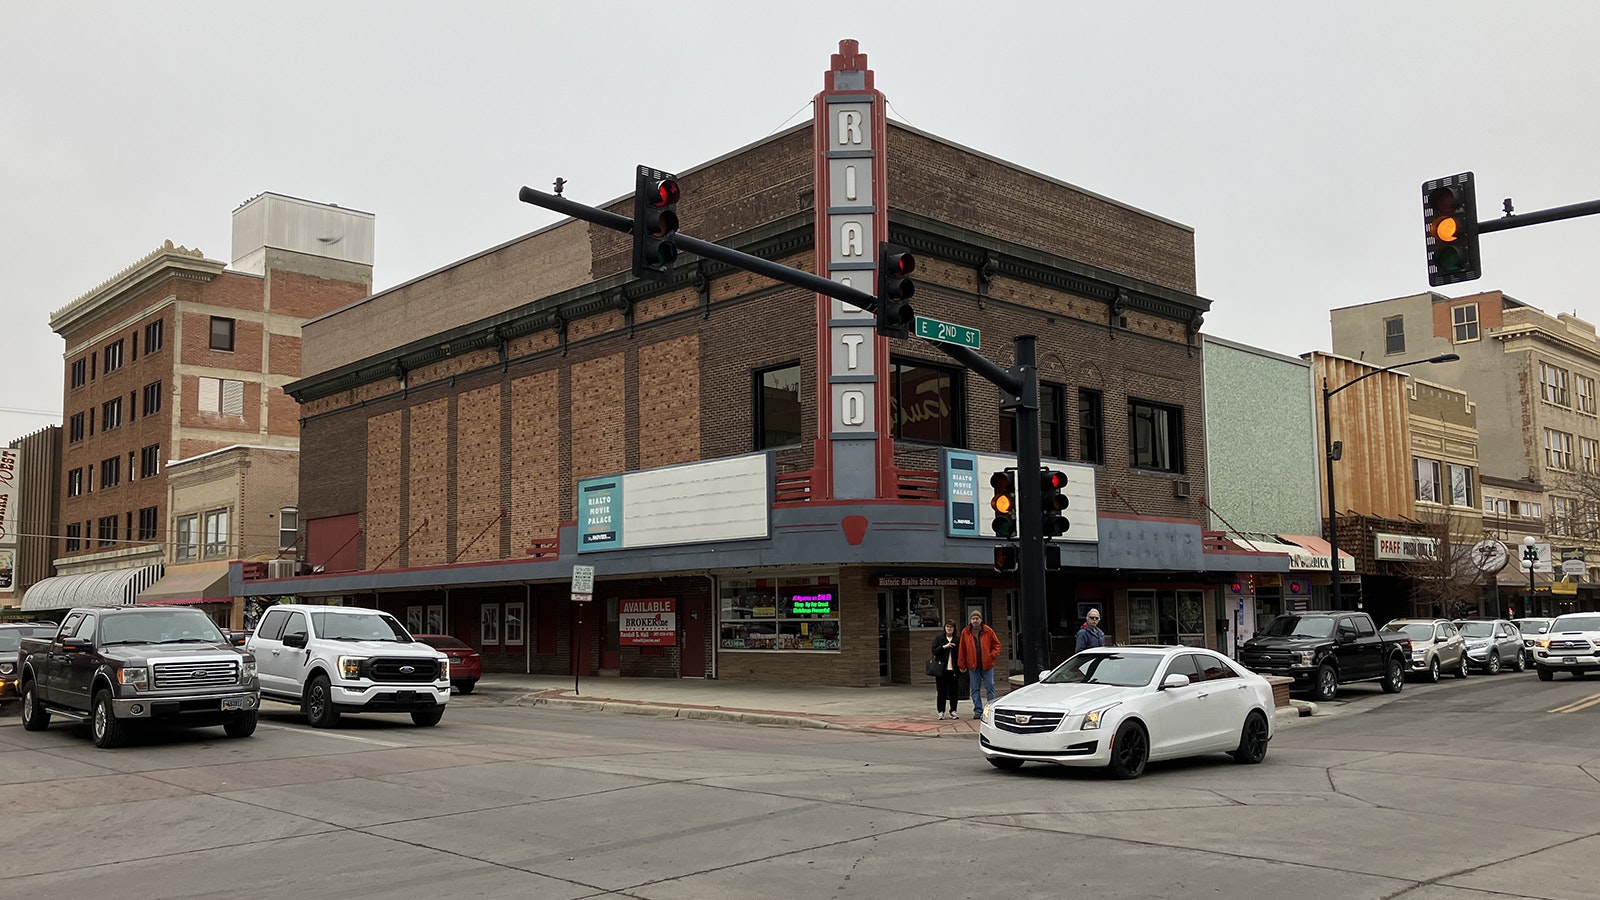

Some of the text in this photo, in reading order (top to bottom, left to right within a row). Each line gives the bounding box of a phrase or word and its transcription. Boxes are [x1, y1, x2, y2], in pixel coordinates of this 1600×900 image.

[838, 109, 865, 426] RIALTO
[922, 321, 975, 343] E 2ND ST
[952, 474, 973, 482] RIALTO
[588, 496, 611, 506] RIALTO
[589, 506, 610, 515] MOVIE
[587, 515, 612, 525] PALACE
[1380, 540, 1401, 554] PFAFF
[879, 577, 900, 586] Historic
[901, 577, 919, 586] Rialto
[919, 577, 933, 586] Soda
[934, 577, 958, 586] Fountain
[623, 601, 671, 613] AVAILABLE
